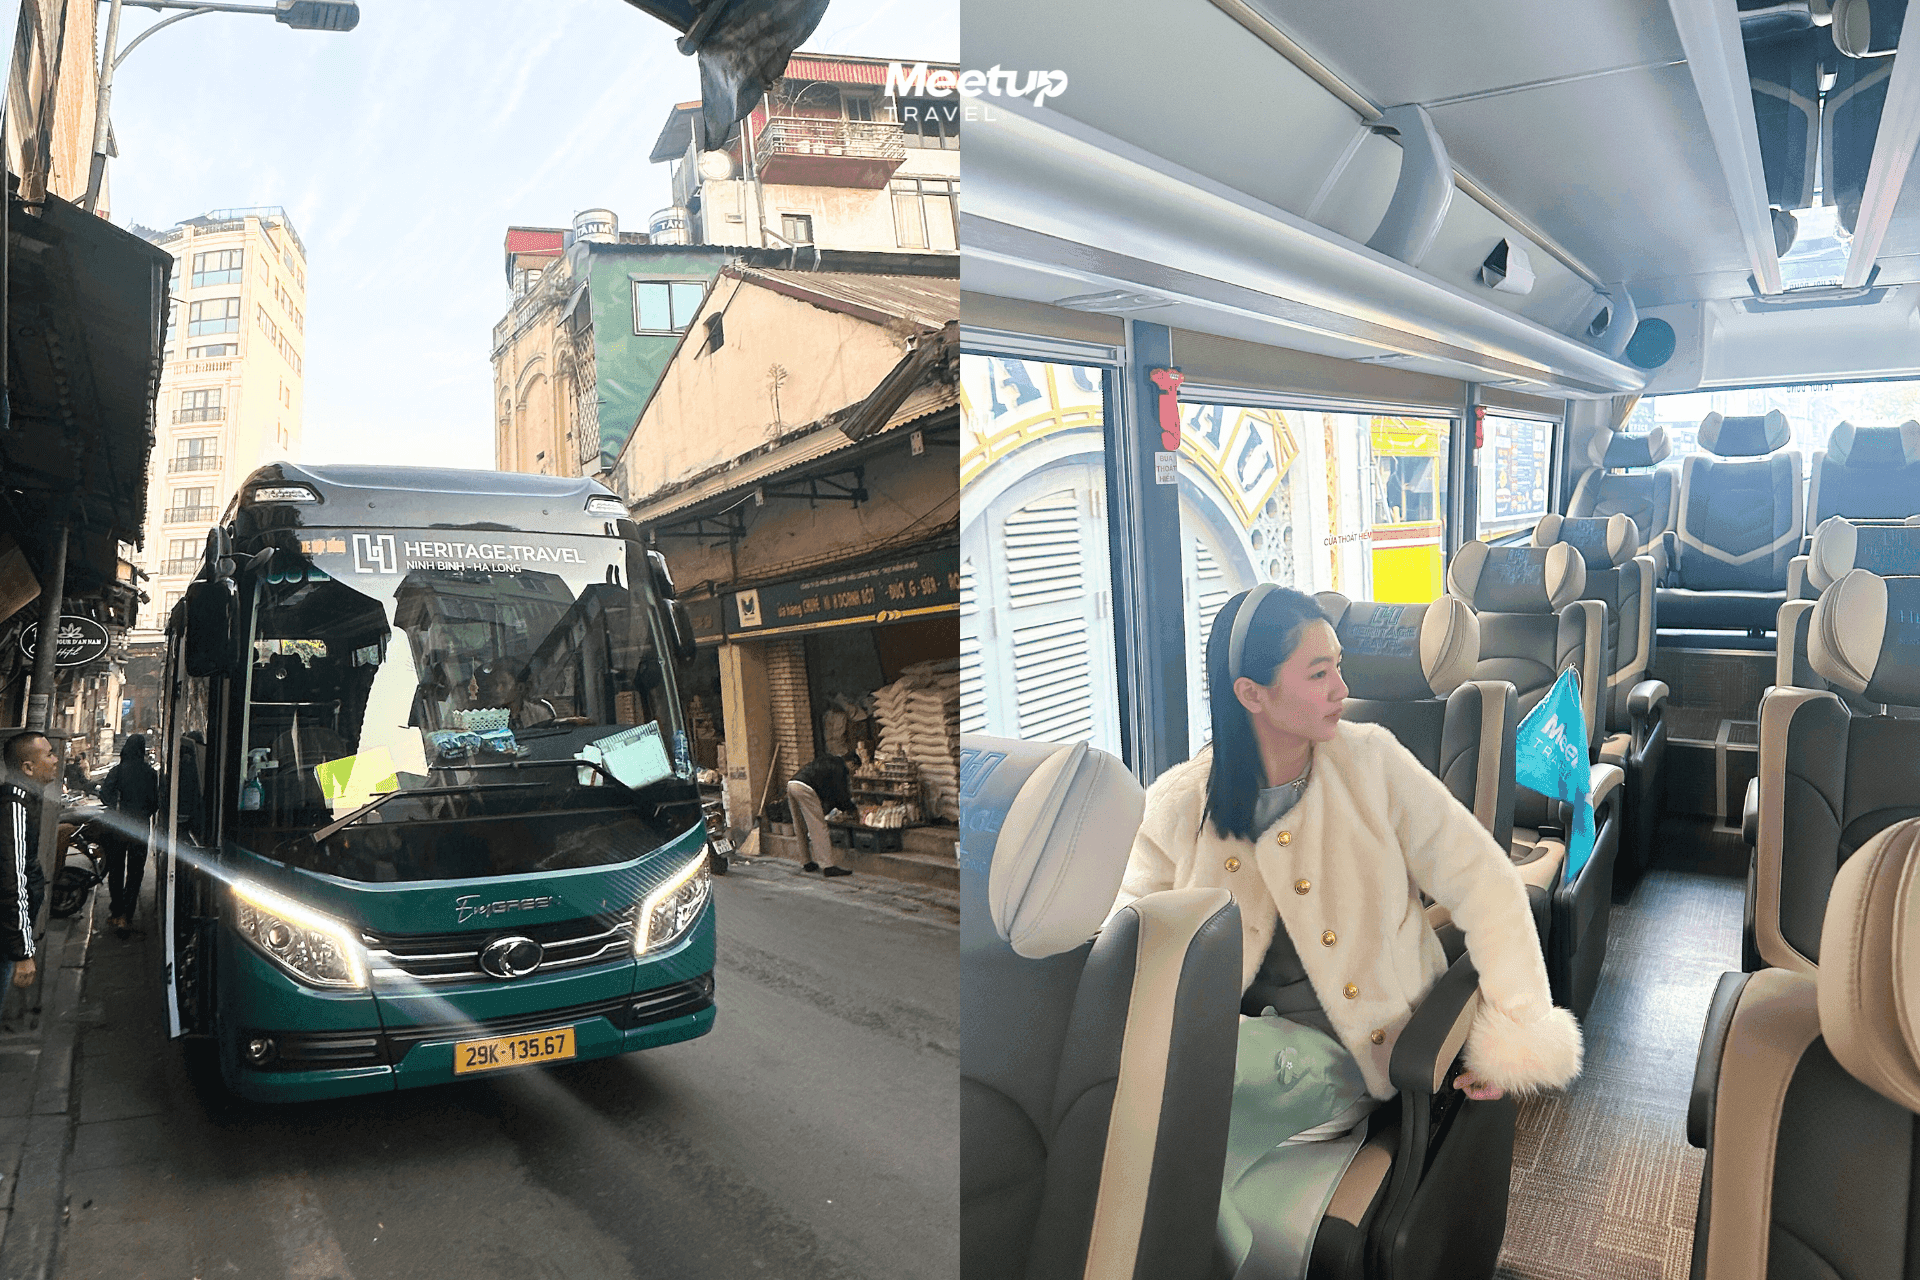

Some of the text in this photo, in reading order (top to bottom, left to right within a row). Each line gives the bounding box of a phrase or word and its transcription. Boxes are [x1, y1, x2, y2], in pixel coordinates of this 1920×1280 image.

[406, 560, 435, 570] NINH
[437, 561, 465, 571] BINH
[473, 562, 490, 572] HA
[491, 563, 522, 573] LONG
[465, 1033, 567, 1067] 29K-135.67
